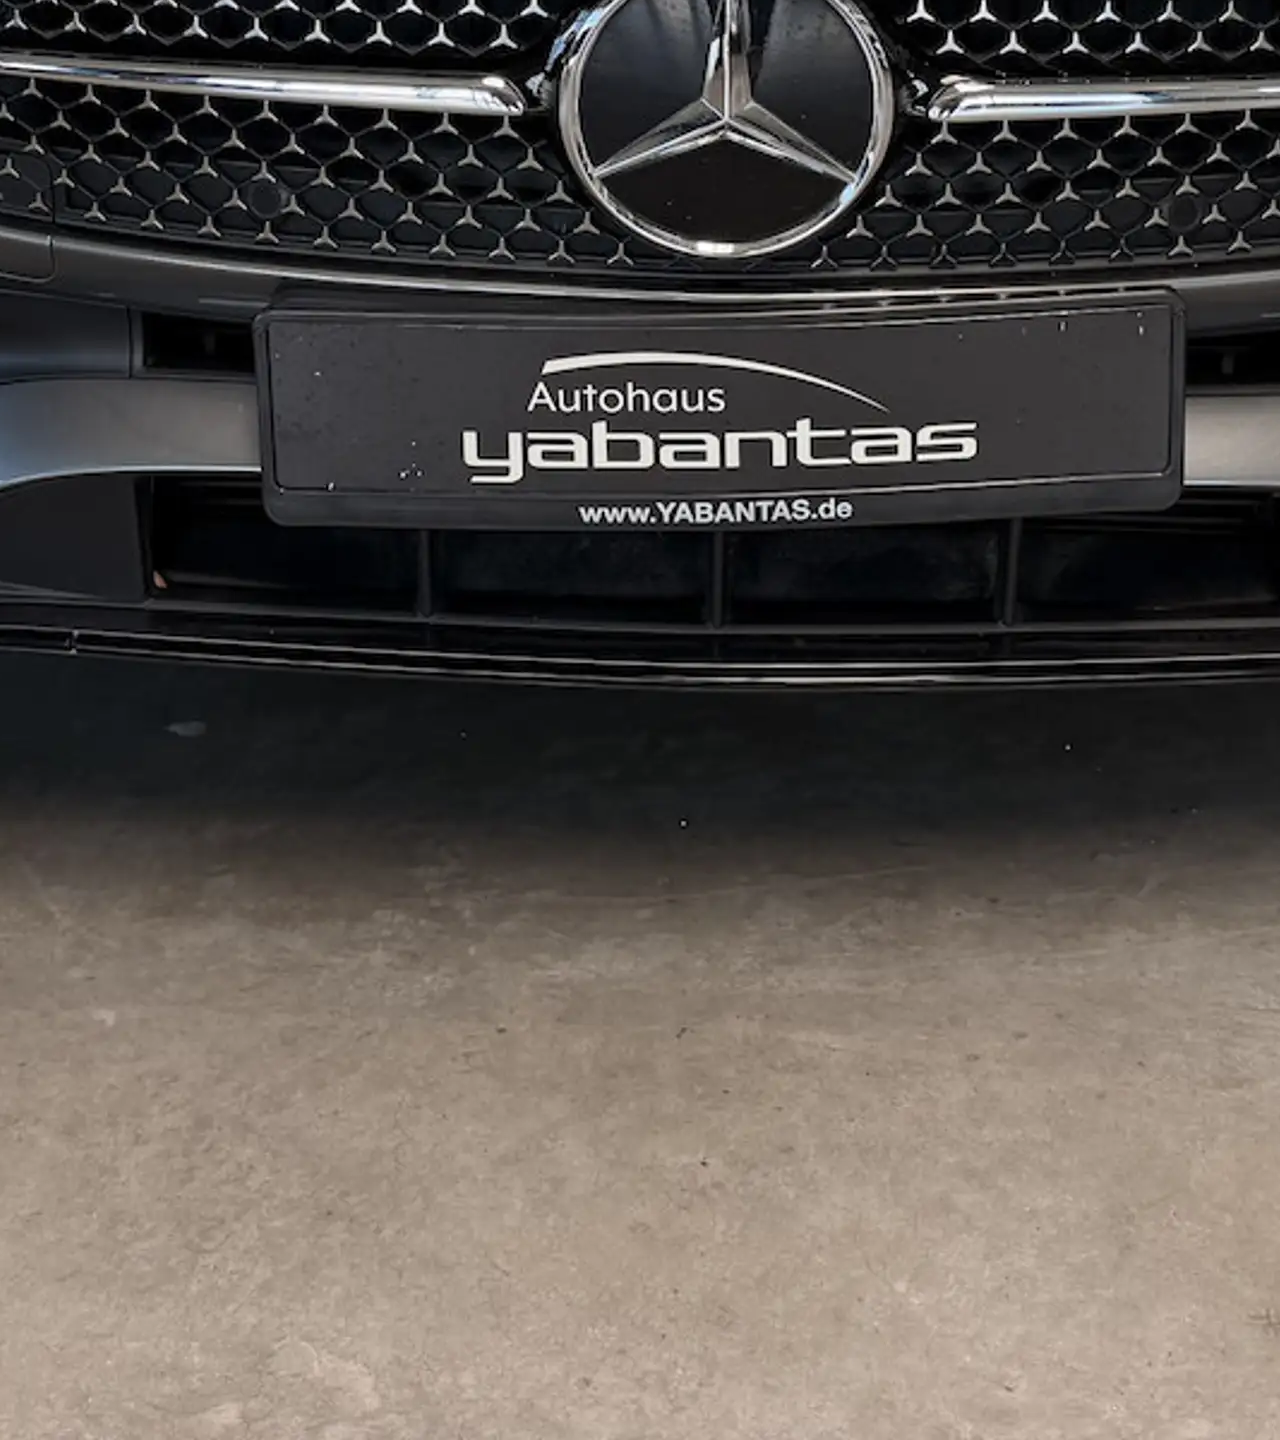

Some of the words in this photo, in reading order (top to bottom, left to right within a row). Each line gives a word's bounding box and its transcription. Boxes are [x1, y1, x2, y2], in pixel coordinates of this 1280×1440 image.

[526, 380, 727, 414] Autohaus
[461, 417, 978, 484] yabantas
[577, 496, 854, 525] www.YABANTAS.de
